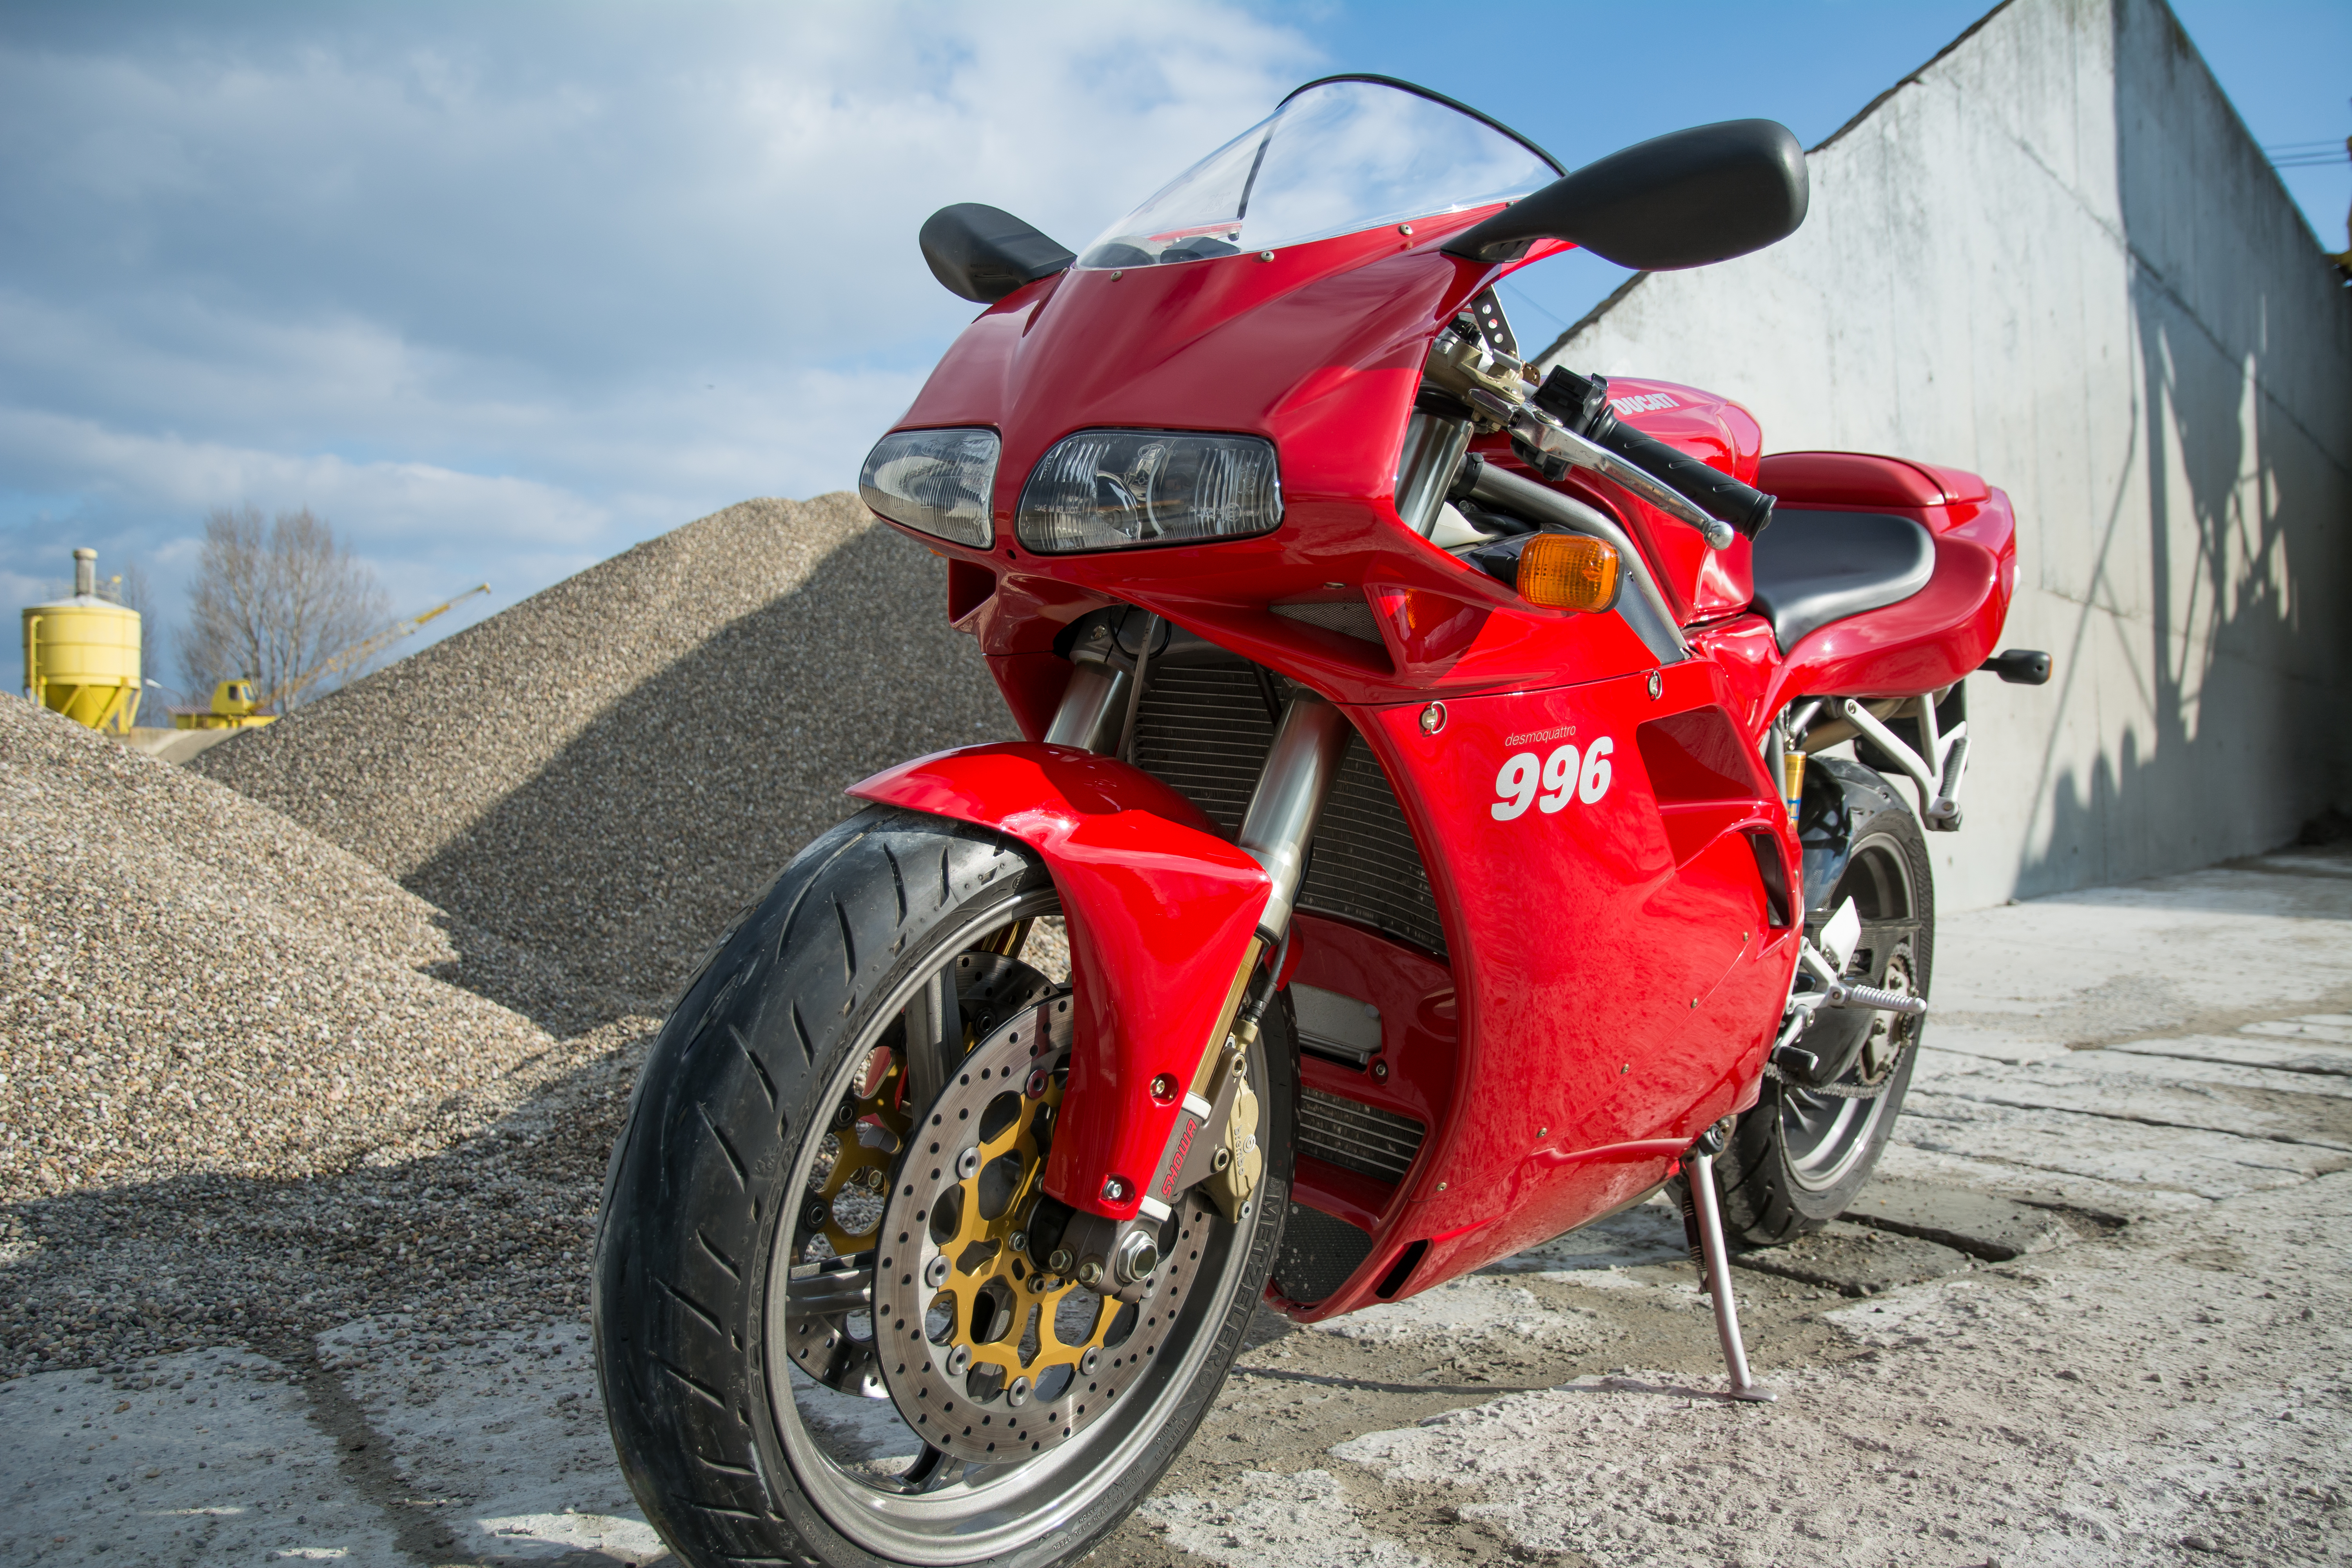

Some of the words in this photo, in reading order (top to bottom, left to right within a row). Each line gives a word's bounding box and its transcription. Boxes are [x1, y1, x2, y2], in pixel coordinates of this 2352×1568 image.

[1609, 393, 1681, 416] DUCATI
[1505, 726, 1576, 747] desmoquattro
[1491, 736, 1613, 821] 996
[1161, 1118, 1197, 1200] SHOWA
[1234, 1124, 1246, 1175] brembo
[1209, 1194, 1280, 1367] METZELER
[1152, 1416, 1178, 1446] RADIAL
[1155, 1418, 1189, 1461] TUBELESS
[1078, 1506, 1098, 1524] RAYON
[1093, 1504, 1112, 1523] RAYON
[1052, 1536, 1073, 1552] STEEL
